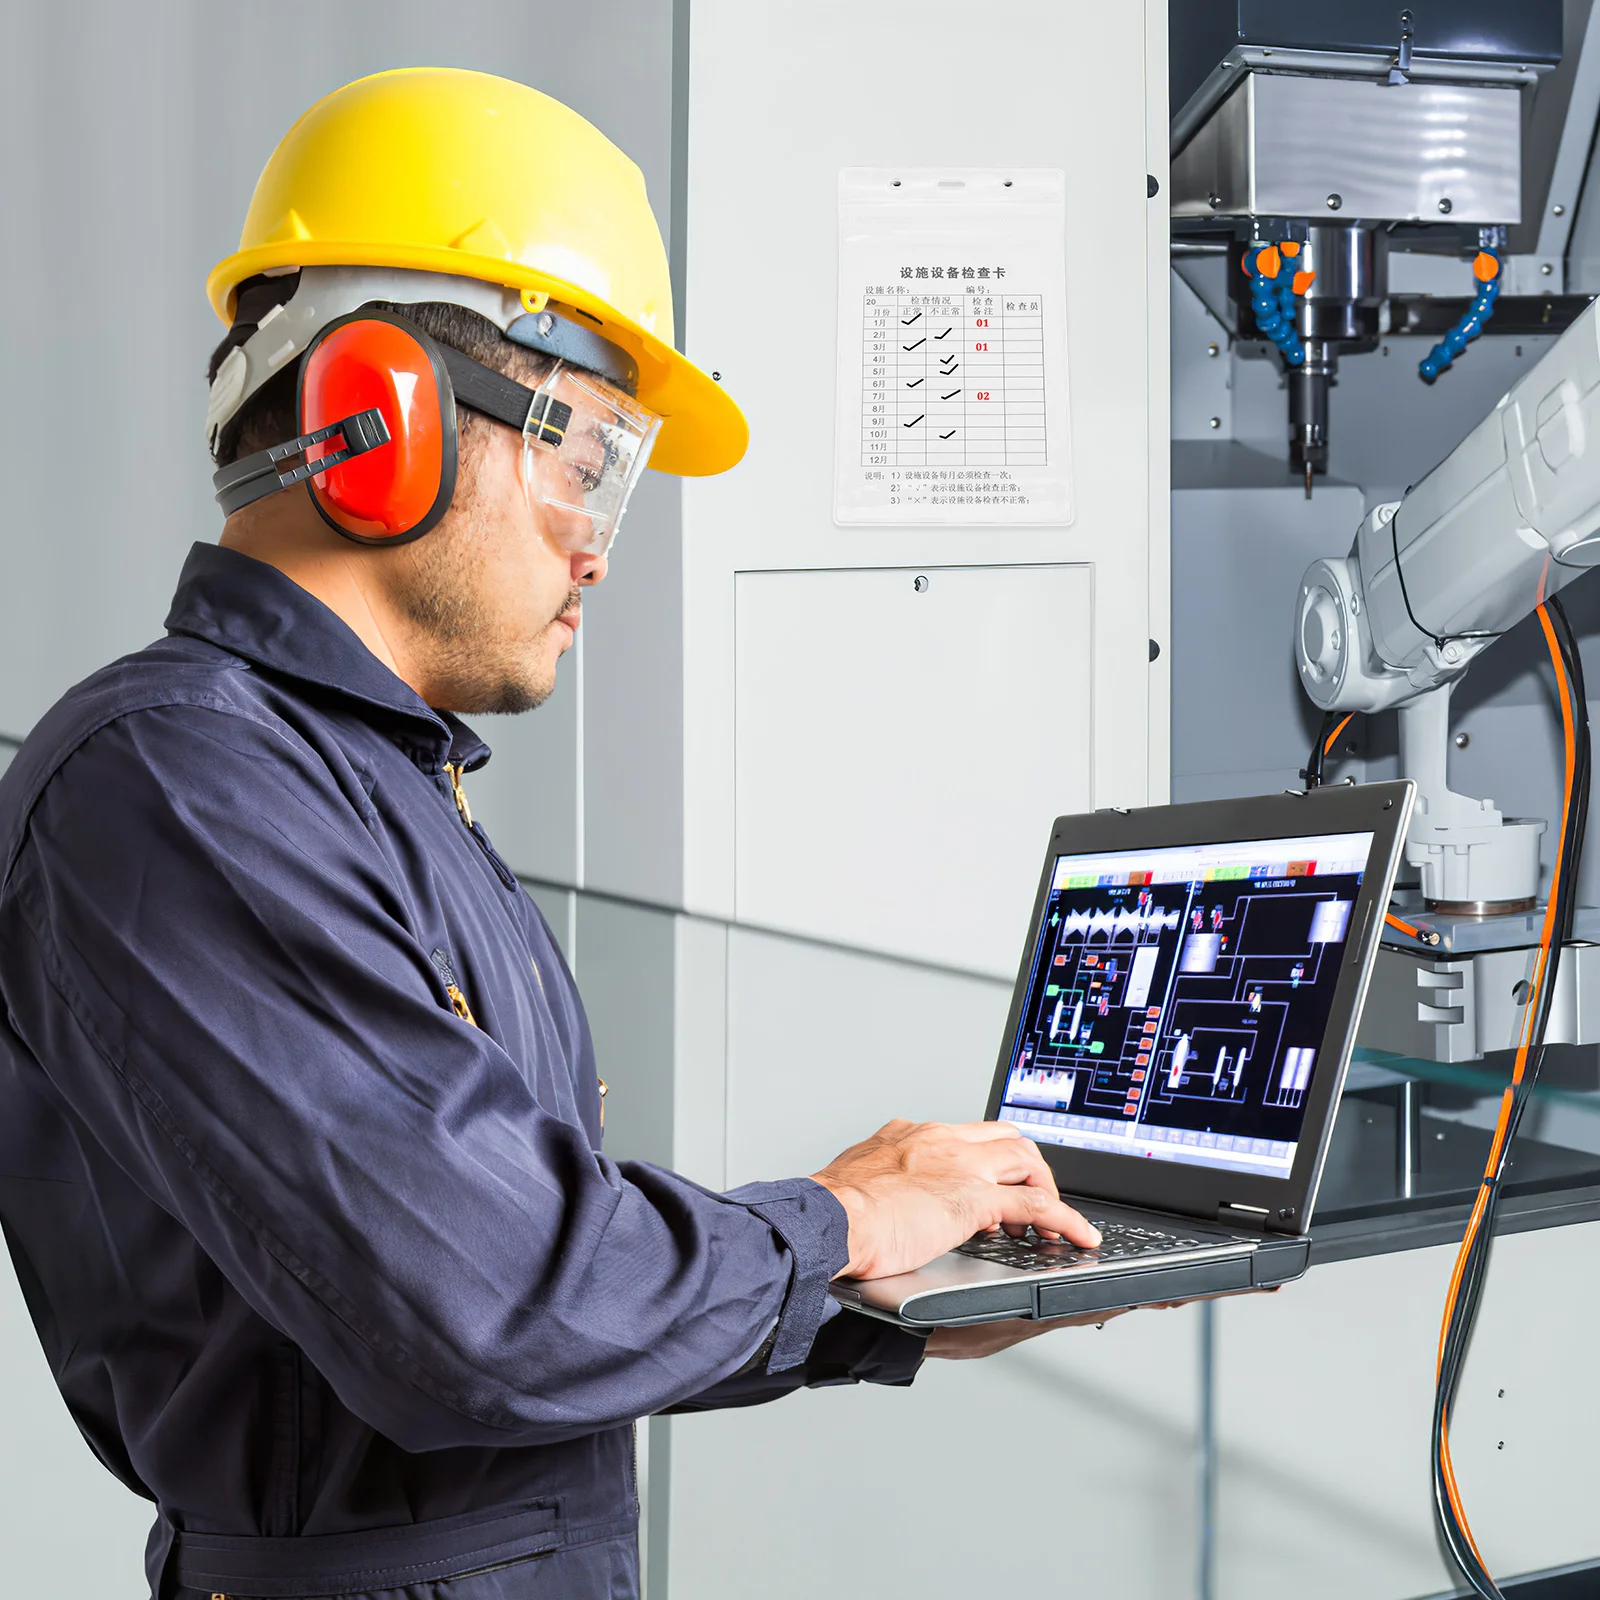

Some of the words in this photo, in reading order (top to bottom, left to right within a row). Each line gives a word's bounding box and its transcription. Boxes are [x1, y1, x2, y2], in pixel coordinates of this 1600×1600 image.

[900, 266, 1006, 279] 设施设备检查卡
[911, 297, 951, 305] 检查情况
[972, 297, 993, 306] 检查
[1006, 302, 1038, 310] 检查员
[972, 307, 993, 316] 备注
[874, 319, 885, 327] 1月
[976, 319, 989, 327] 01
[873, 331, 885, 339] 2月
[976, 343, 988, 351] 01
[872, 380, 885, 388] 6月
[977, 392, 989, 400] 02
[872, 405, 885, 413] 8月
[870, 443, 886, 451] 11月
[870, 456, 887, 464] 12月
